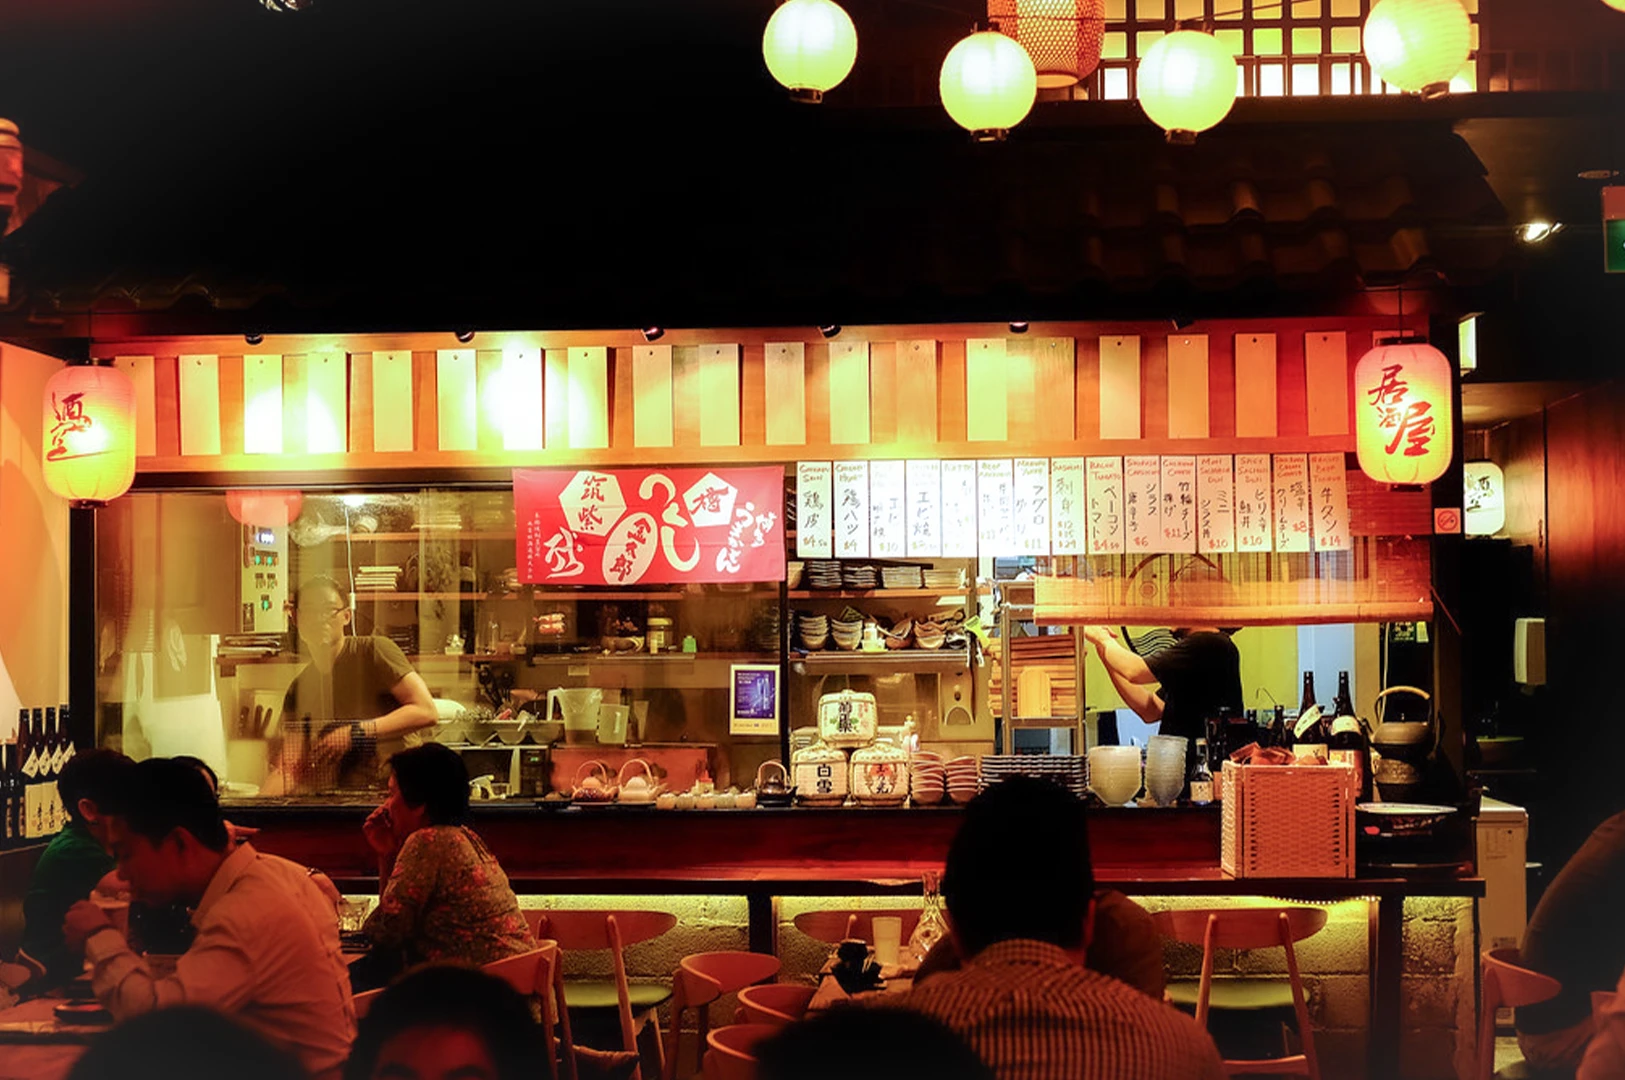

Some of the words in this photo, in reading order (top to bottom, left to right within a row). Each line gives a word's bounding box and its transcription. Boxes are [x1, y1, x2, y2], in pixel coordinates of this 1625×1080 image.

[1368, 363, 1435, 457] 居酒屋
[638, 472, 701, 573] つくし
[816, 763, 833, 794] 白雪
